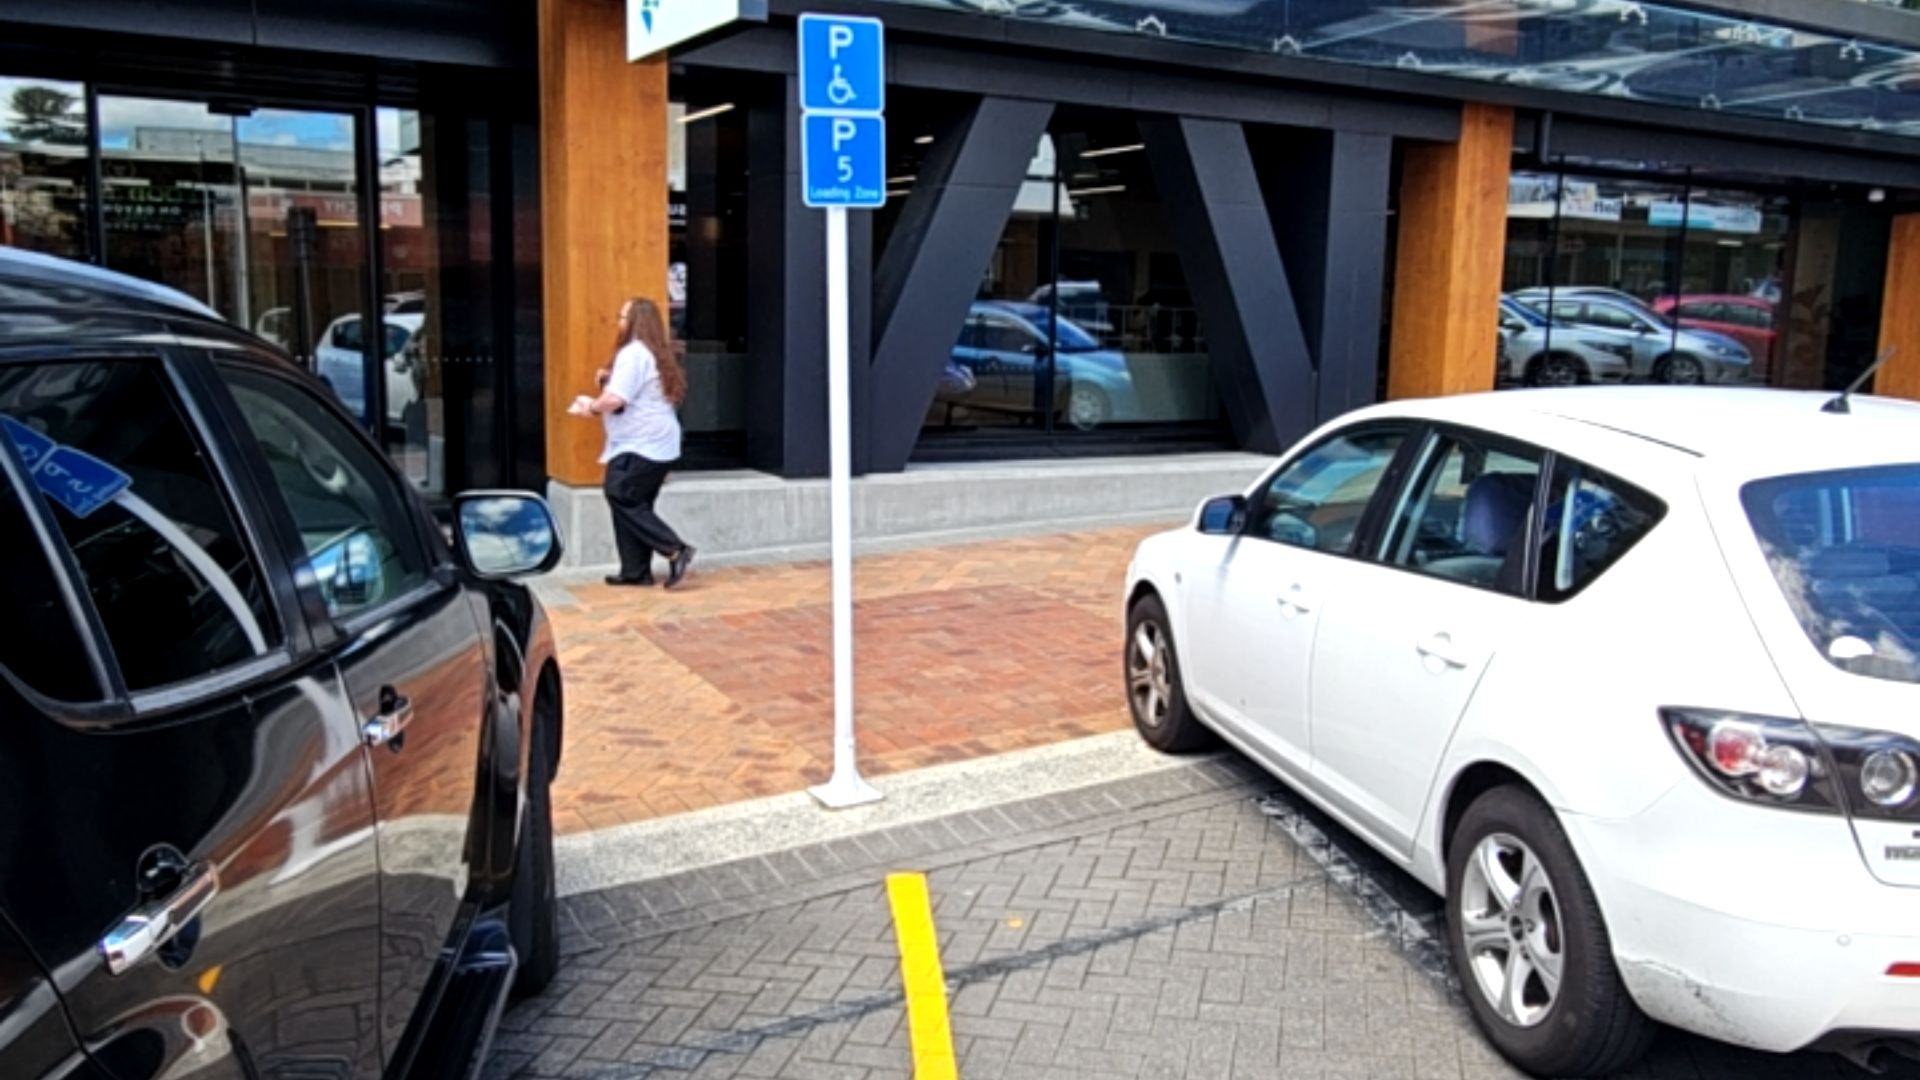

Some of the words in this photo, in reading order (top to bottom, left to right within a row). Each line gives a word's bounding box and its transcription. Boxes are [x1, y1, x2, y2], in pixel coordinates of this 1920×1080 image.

[829, 24, 854, 60] P
[832, 118, 857, 152] P
[837, 155, 854, 182] 5
[810, 185, 851, 203] Loading
[855, 185, 879, 199] Zone
